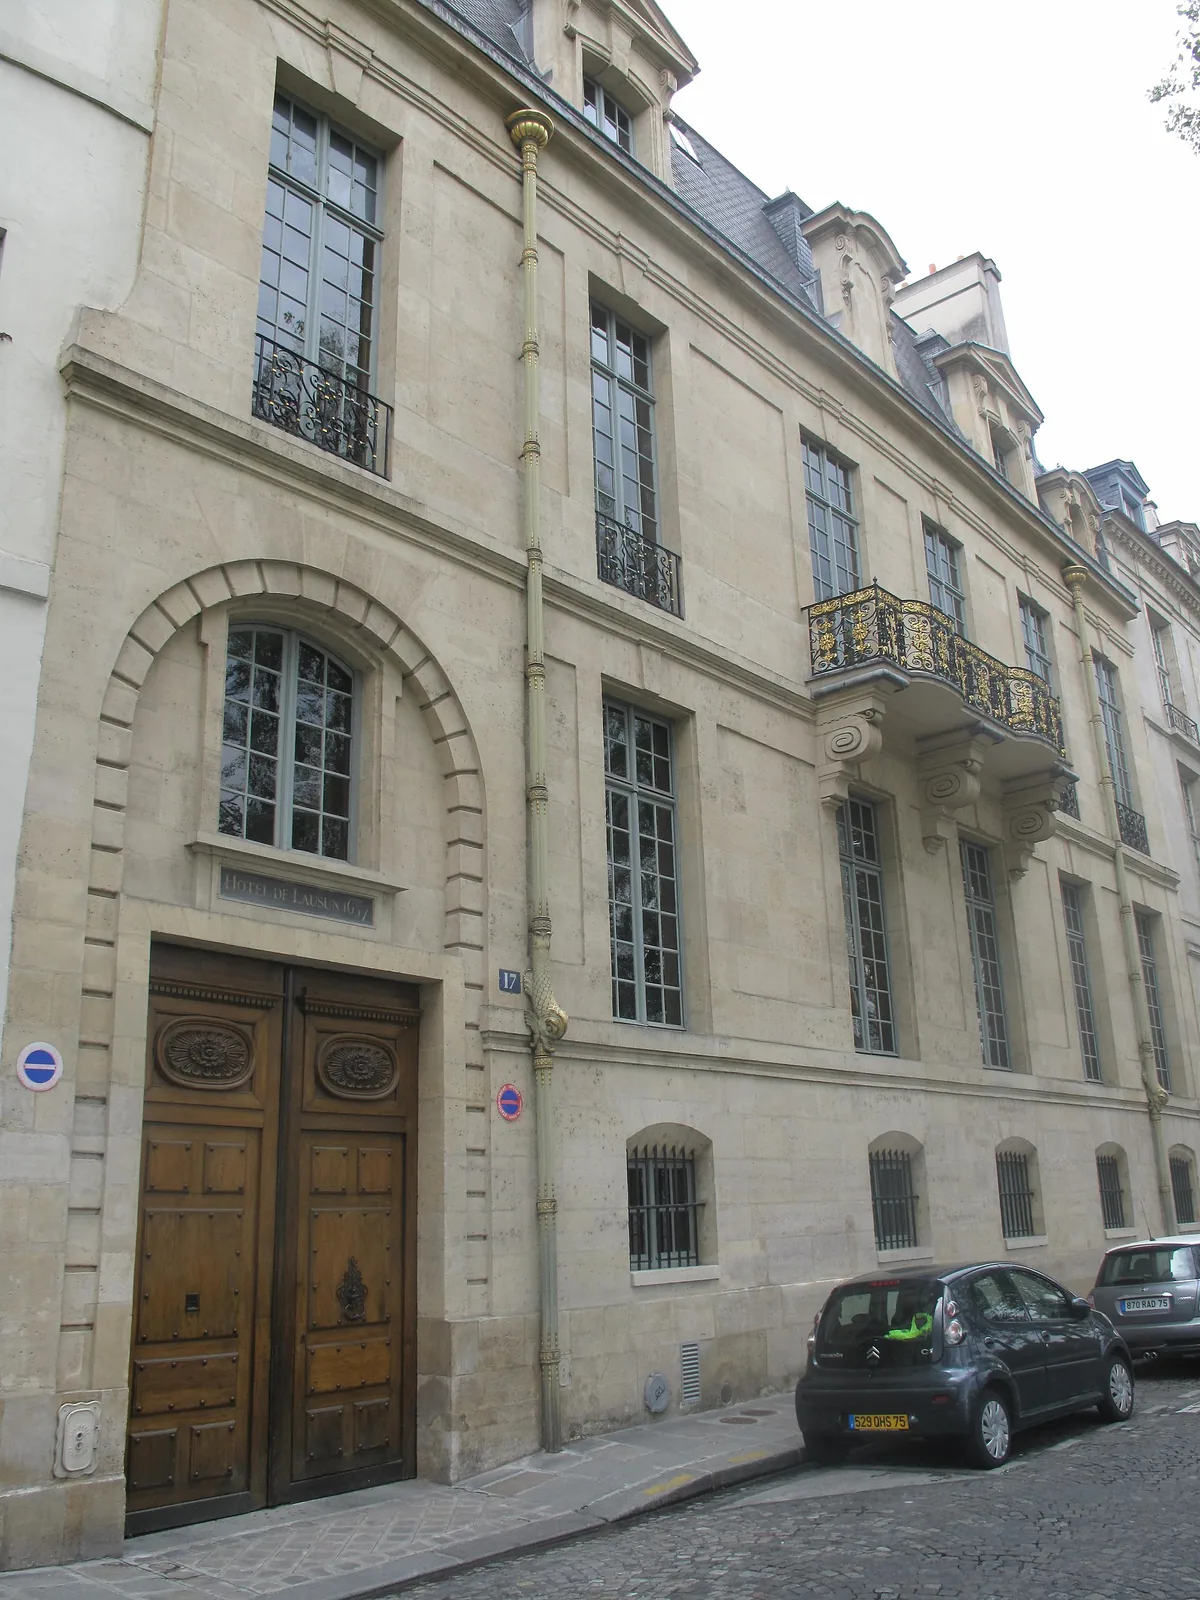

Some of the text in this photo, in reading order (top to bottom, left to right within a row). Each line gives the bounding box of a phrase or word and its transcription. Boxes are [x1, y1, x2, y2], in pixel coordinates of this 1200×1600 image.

[504, 972, 516, 989] 17
[1126, 1299, 1168, 1309] 870 RAD 75
[855, 1416, 872, 1427] 529
[893, 1416, 906, 1427] 75
